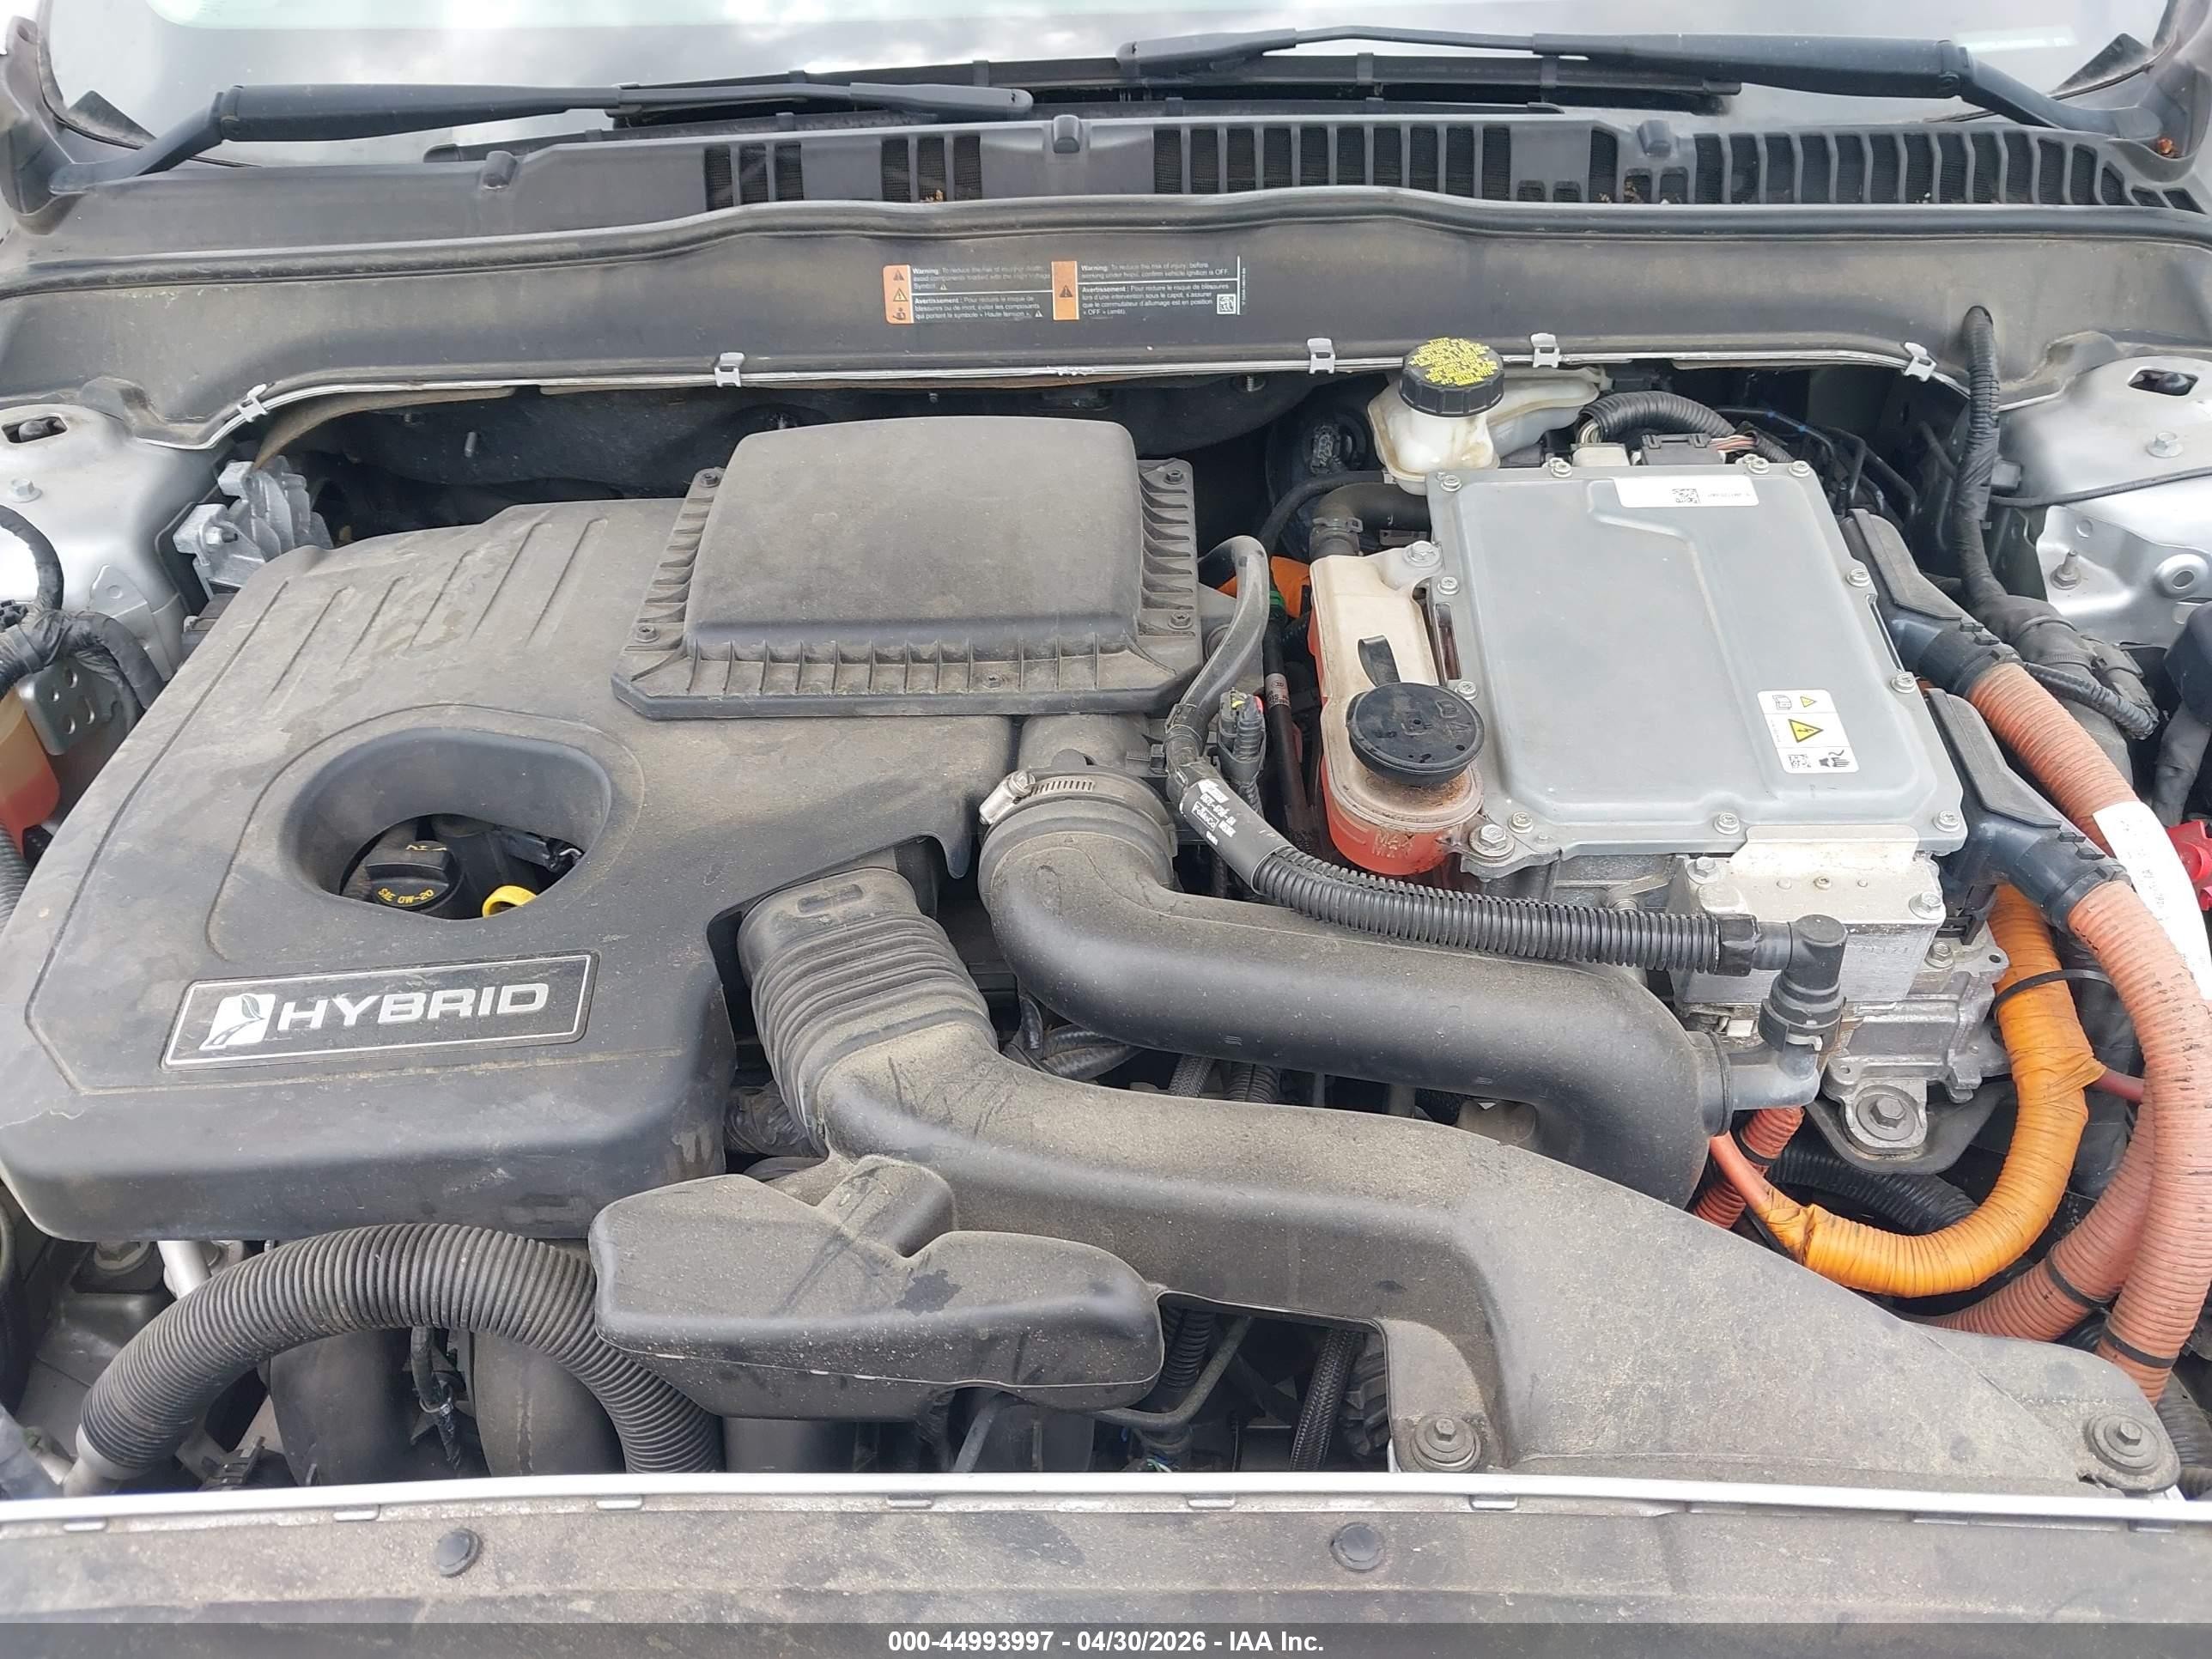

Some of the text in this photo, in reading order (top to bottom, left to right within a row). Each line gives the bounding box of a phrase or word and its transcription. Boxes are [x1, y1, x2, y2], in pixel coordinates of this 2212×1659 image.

[378, 888, 434, 903] SAE 0W-20
[277, 982, 550, 1032] HYBRID
